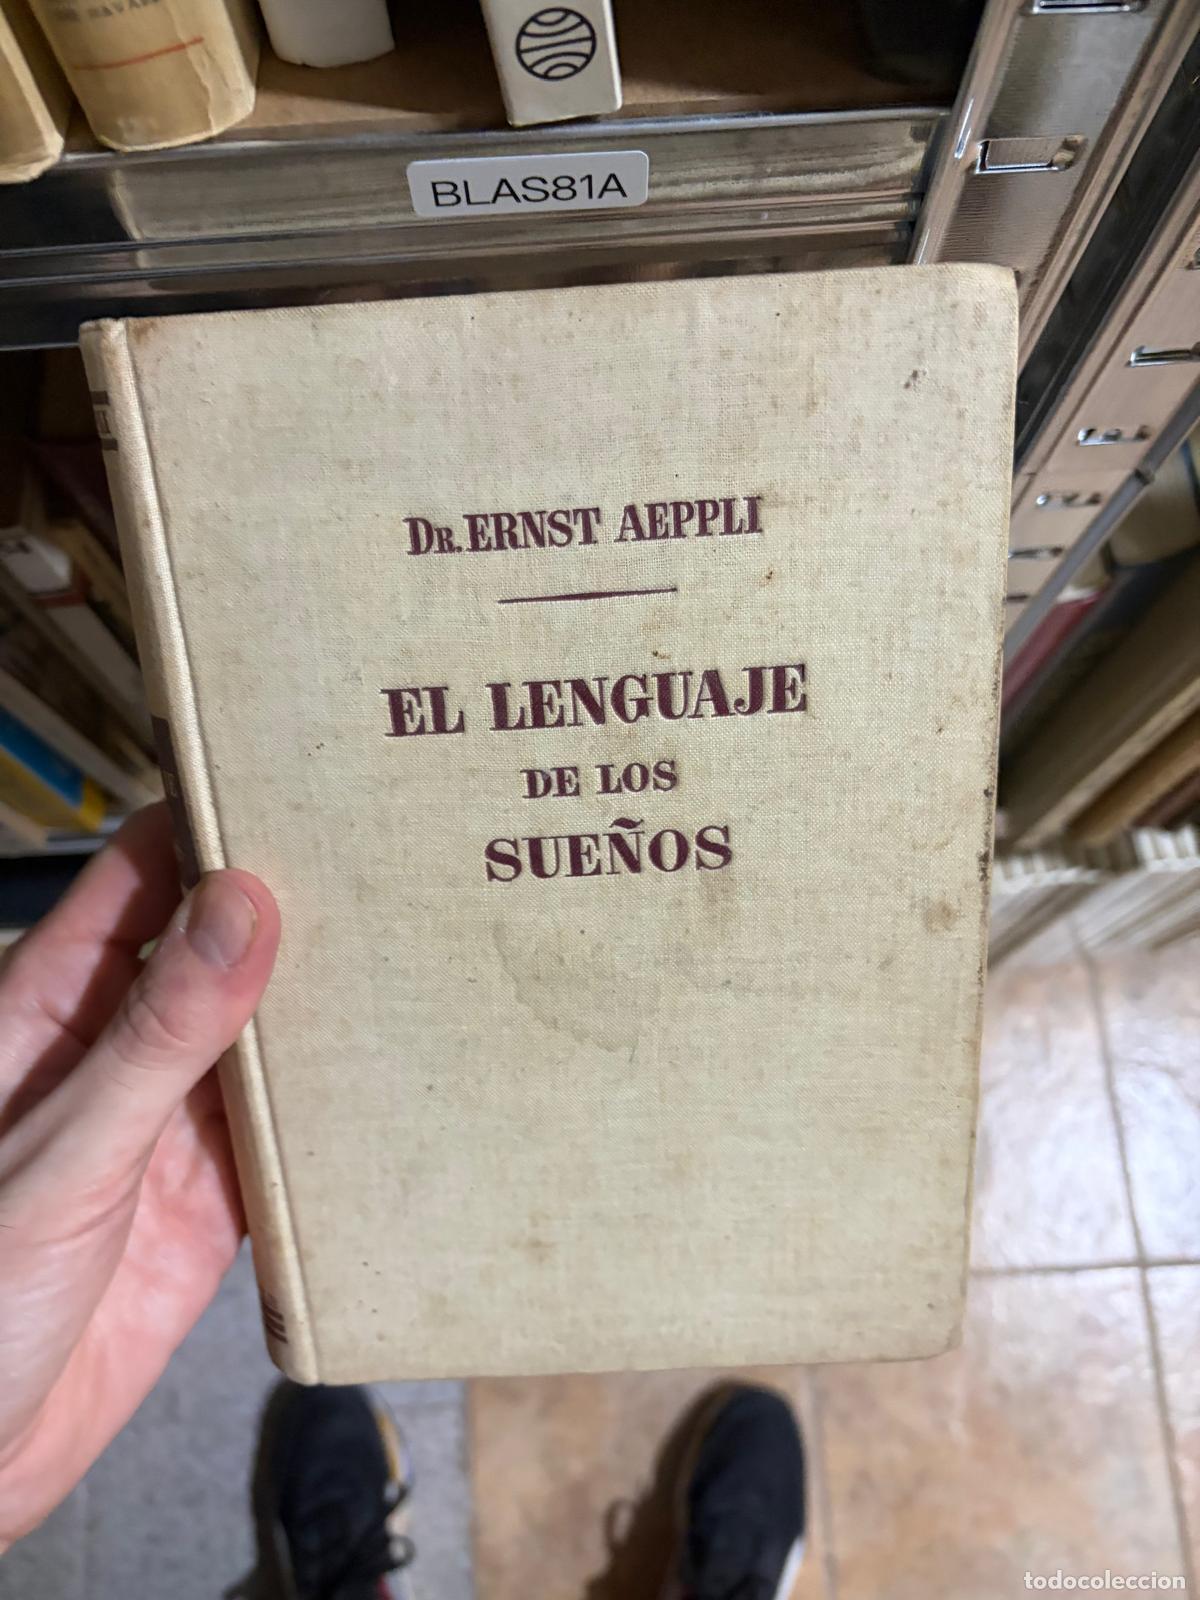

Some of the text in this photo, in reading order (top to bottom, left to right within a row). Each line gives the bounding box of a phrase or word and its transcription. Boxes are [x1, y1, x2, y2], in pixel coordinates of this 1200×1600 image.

[430, 173, 628, 207] BLAS81A
[614, 496, 764, 543] AEPPLI
[380, 664, 808, 738] EL LENGUAJE
[521, 759, 679, 799] DE LOS
[484, 817, 733, 883] SUEÑOS
